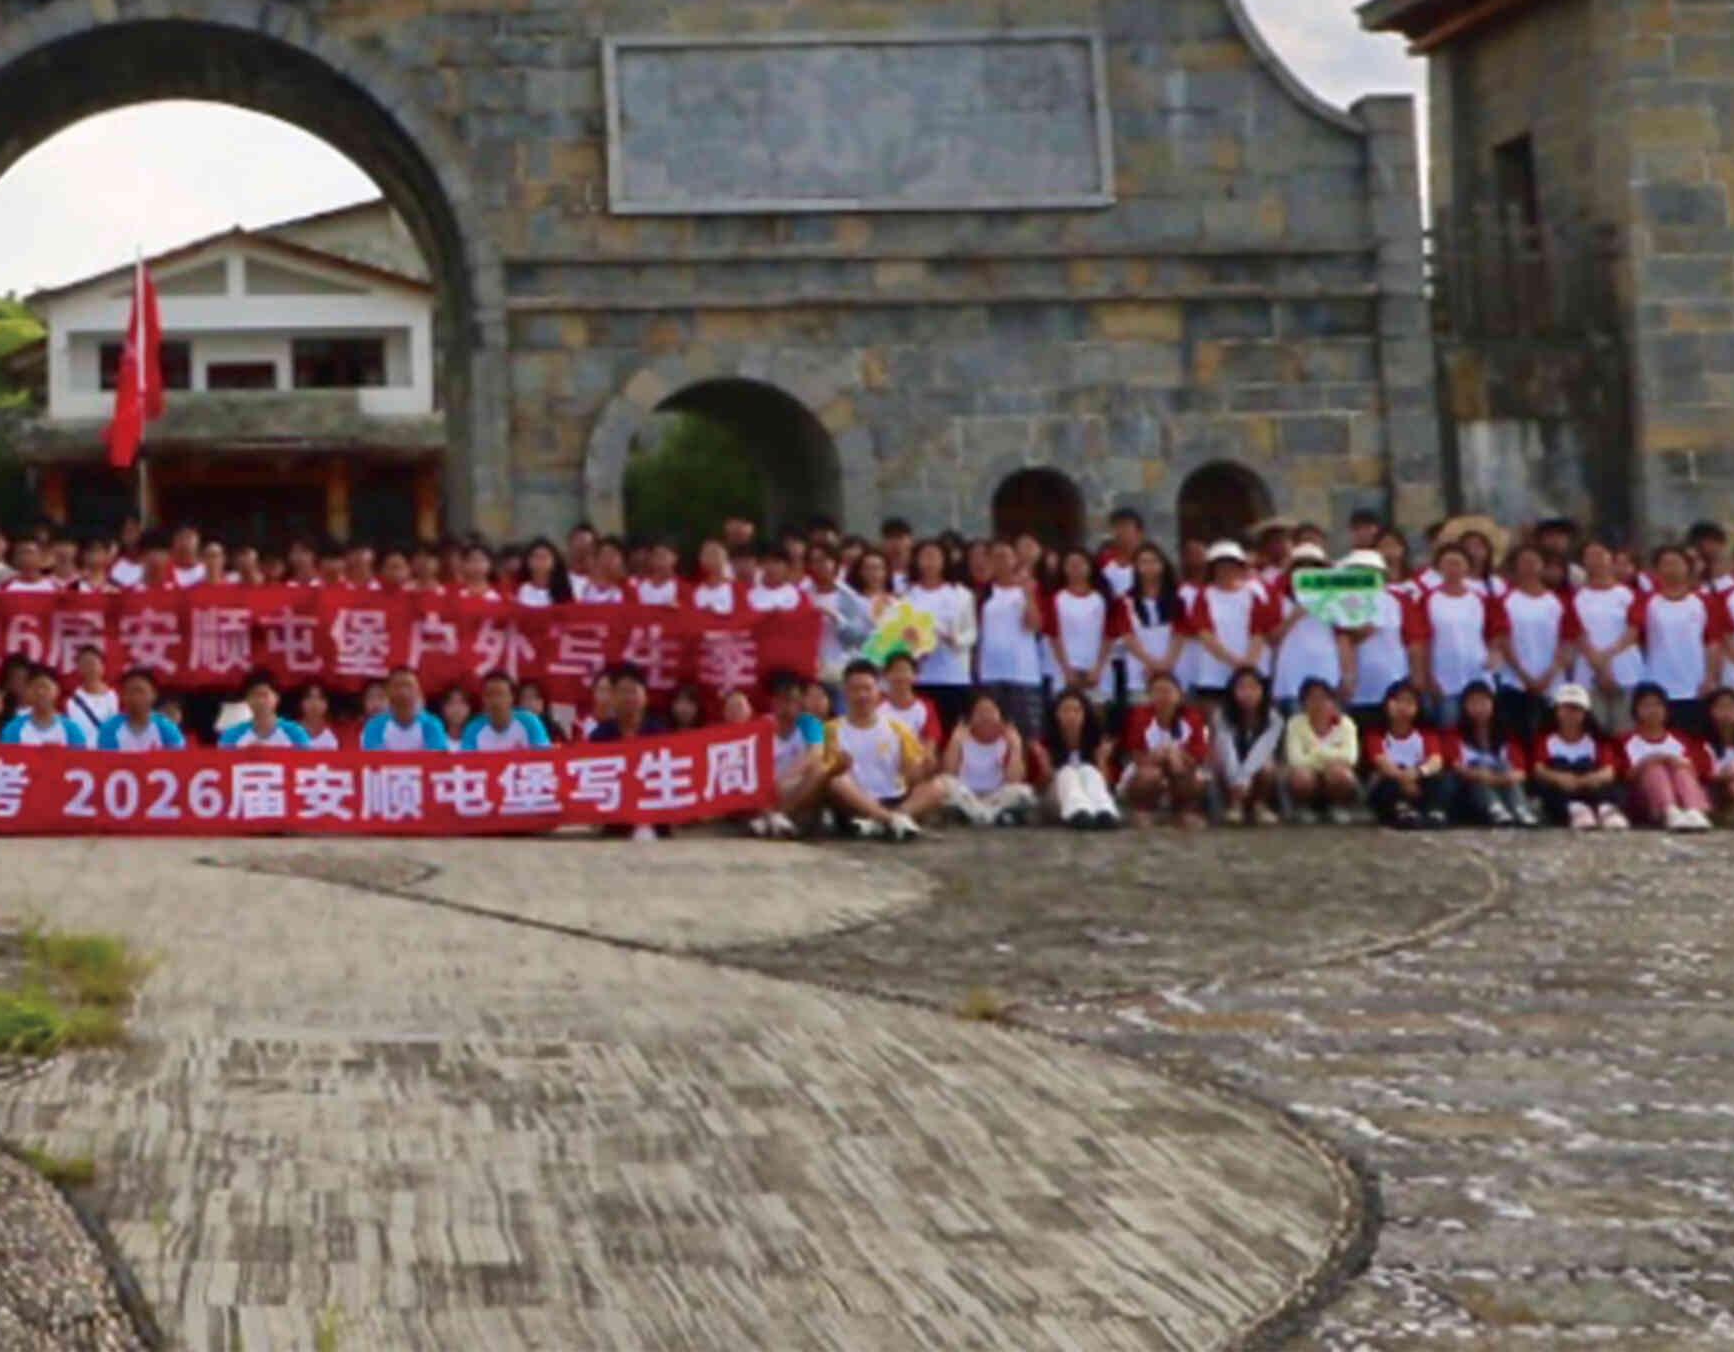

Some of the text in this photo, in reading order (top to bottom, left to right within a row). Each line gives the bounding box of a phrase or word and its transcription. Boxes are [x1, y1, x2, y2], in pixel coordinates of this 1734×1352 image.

[63, 734, 759, 820] 2026届安顺屯堡写生周
